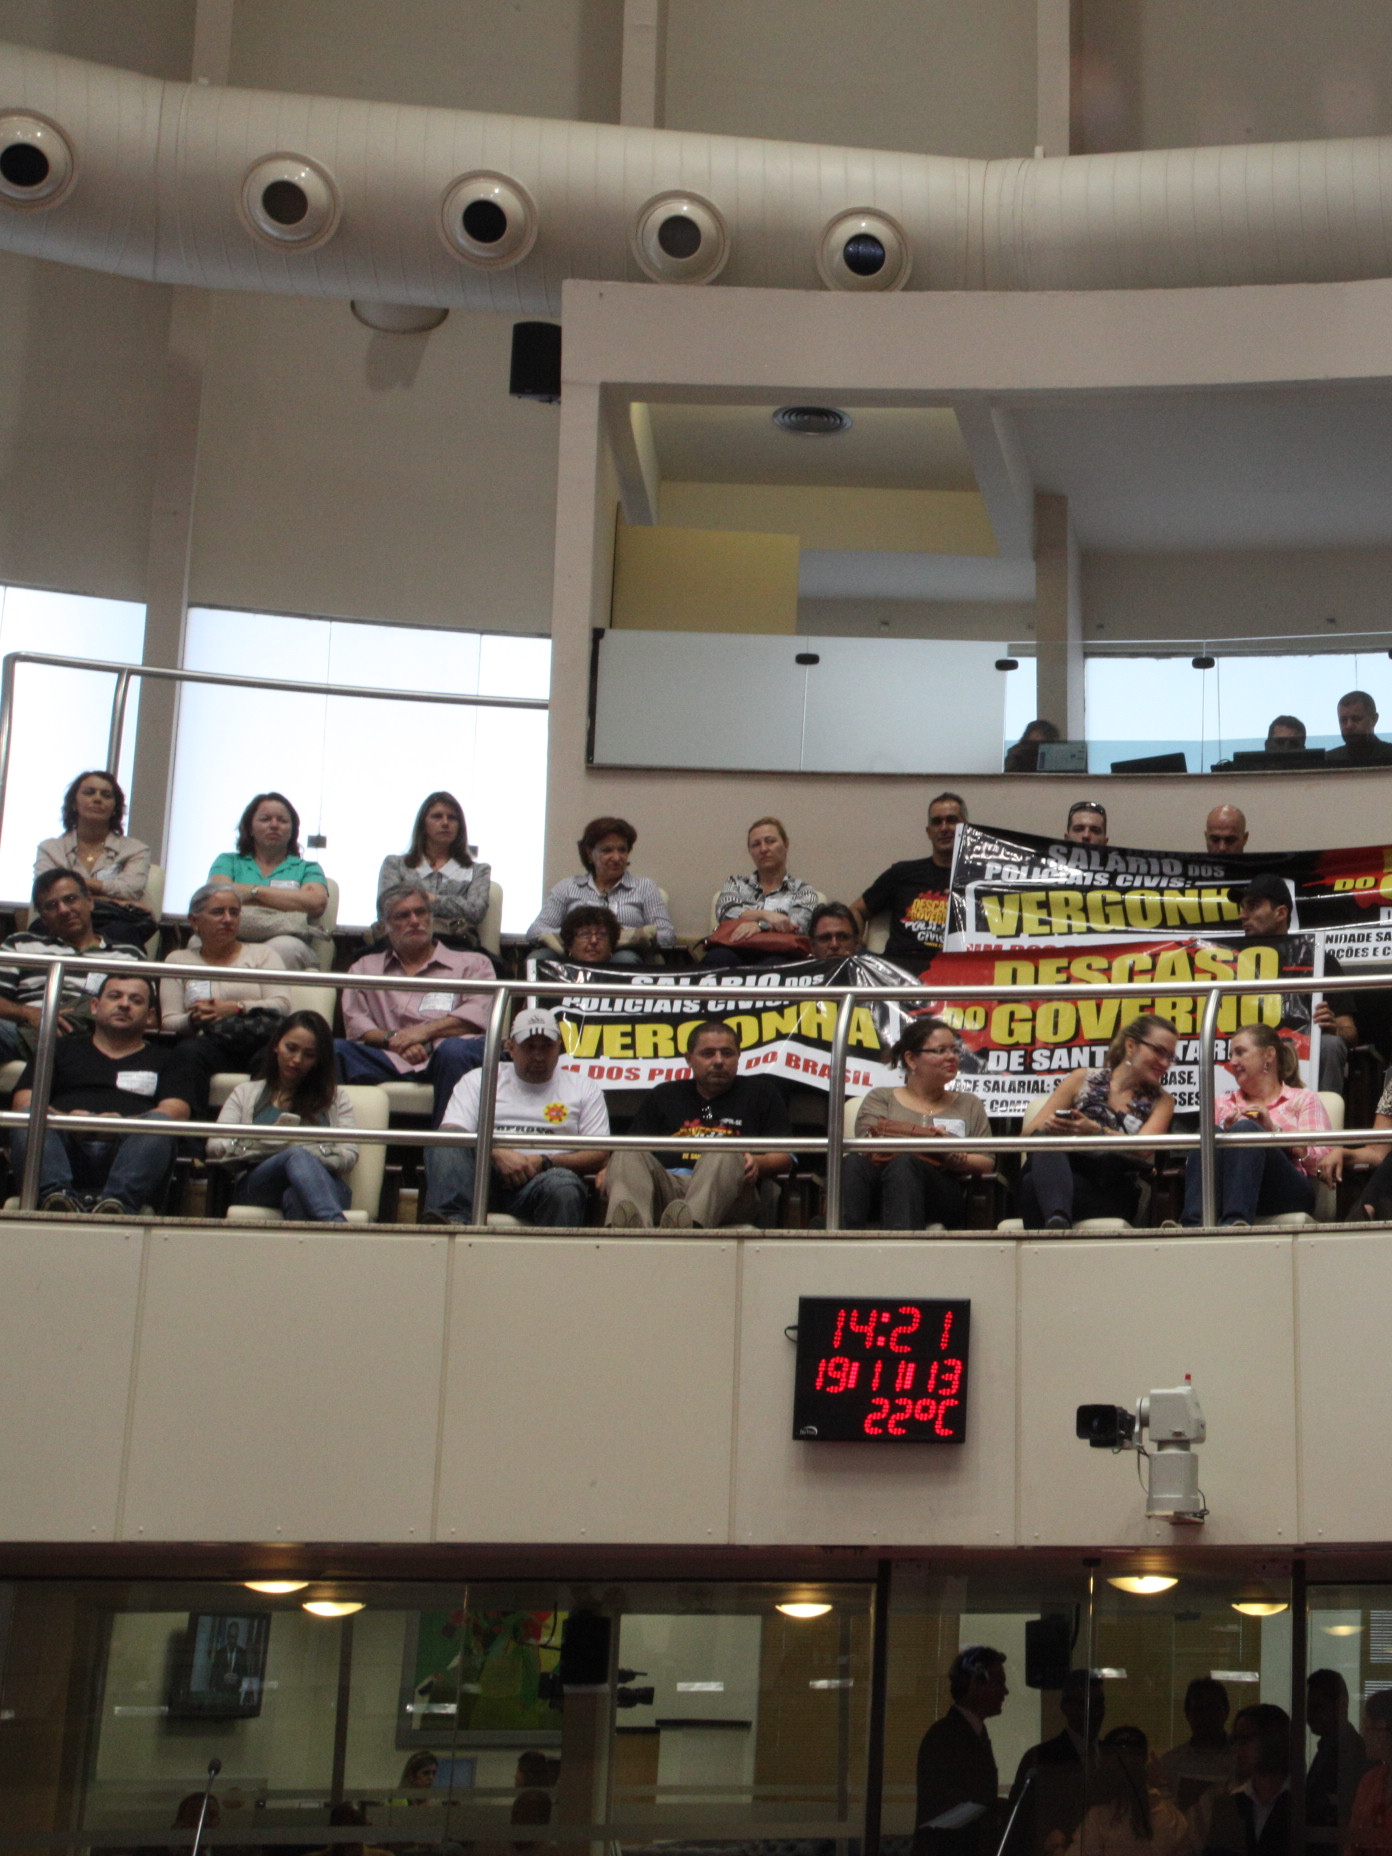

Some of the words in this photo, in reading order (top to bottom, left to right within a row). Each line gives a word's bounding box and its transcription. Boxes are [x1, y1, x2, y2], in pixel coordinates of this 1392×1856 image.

[985, 862, 1112, 887] POLICIAIS
[1049, 844, 1183, 876] SALÁRIO
[1188, 863, 1225, 878] DOS
[1333, 875, 1377, 892] DO
[981, 887, 1243, 937] VERGONH
[1373, 947, 1379, 957] E
[994, 946, 1280, 986] DESCASO
[943, 1005, 987, 1031] DO
[588, 1065, 641, 1081] DOS
[648, 1068, 693, 1081] PIO
[745, 1051, 778, 1070] DO
[988, 1049, 1025, 1072] DE
[1032, 1045, 1109, 1071] SANT
[983, 1079, 1051, 1093] SALARIAL:
[832, 1305, 954, 1354] 14:21
